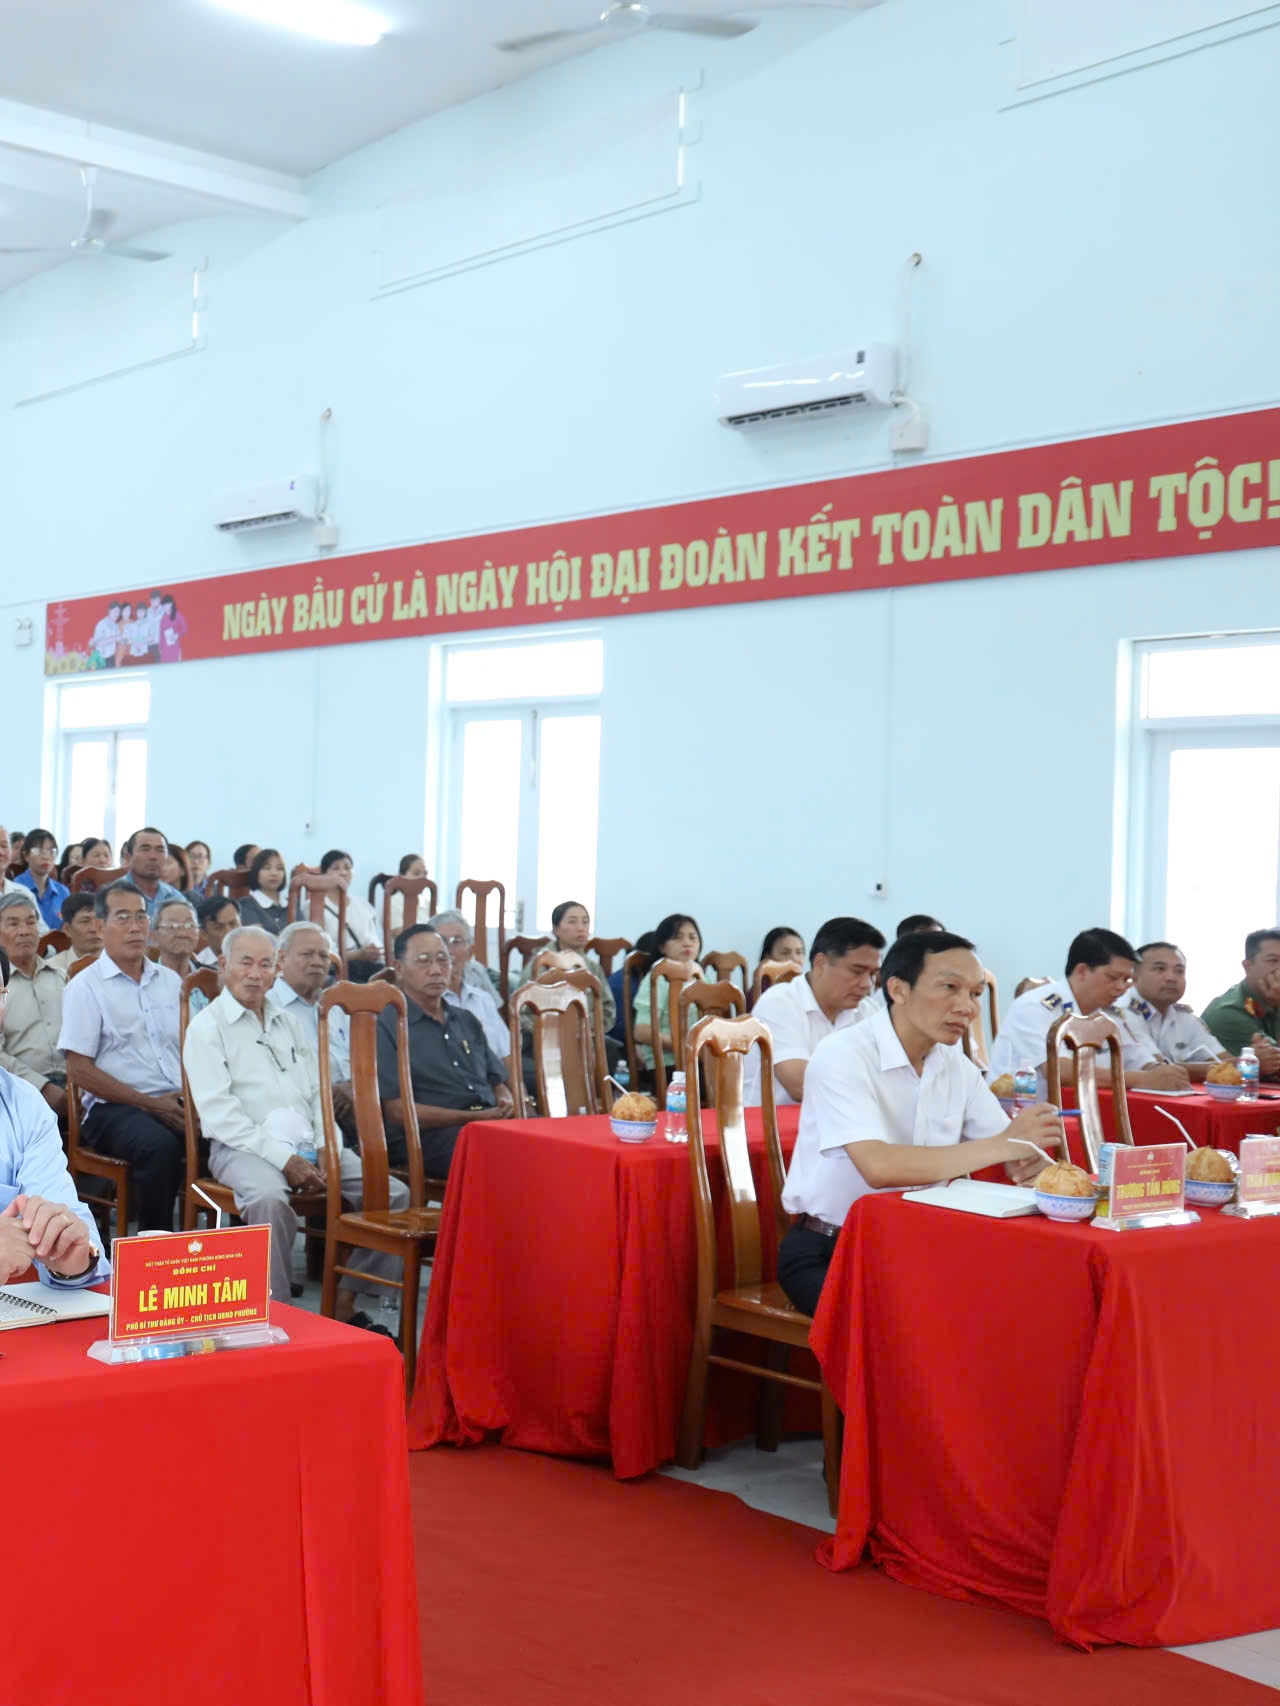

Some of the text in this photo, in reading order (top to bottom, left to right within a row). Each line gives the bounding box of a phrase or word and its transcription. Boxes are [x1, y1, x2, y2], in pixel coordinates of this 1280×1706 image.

[222, 456, 1280, 640] NGÀY BẦU CỬ LÀ NGÀY HỘI ĐẠI ĐOÀN KẾT TOÀN DÂN TỘC!
[201, 1263, 216, 1272] CHÍ
[139, 1277, 247, 1312] LÊ MINH TÂM
[147, 1319, 159, 1328] THƯ
